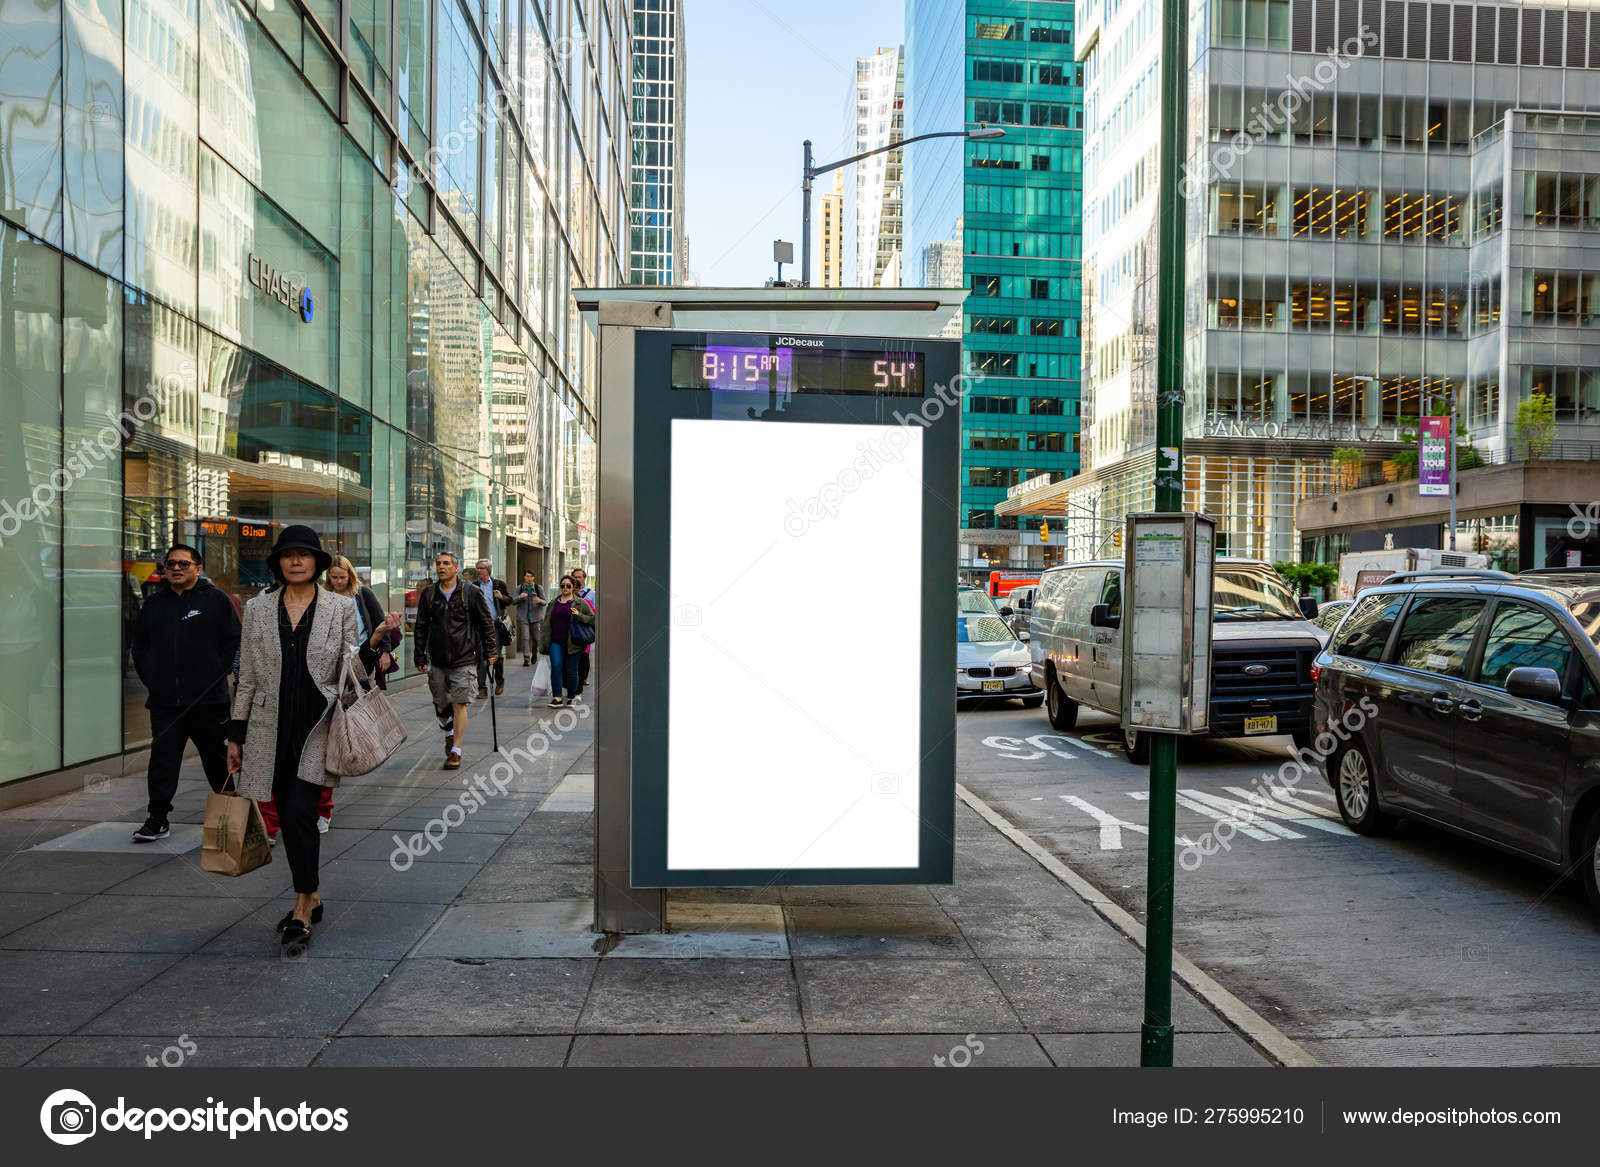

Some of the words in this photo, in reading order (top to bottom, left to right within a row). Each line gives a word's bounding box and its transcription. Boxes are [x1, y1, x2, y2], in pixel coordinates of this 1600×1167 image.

[248, 252, 298, 314] CHASE
[775, 336, 824, 348] JCDecaux
[702, 352, 760, 382] 8:15
[1203, 419, 1257, 438] BANK
[1423, 459, 1446, 467] TOUR
